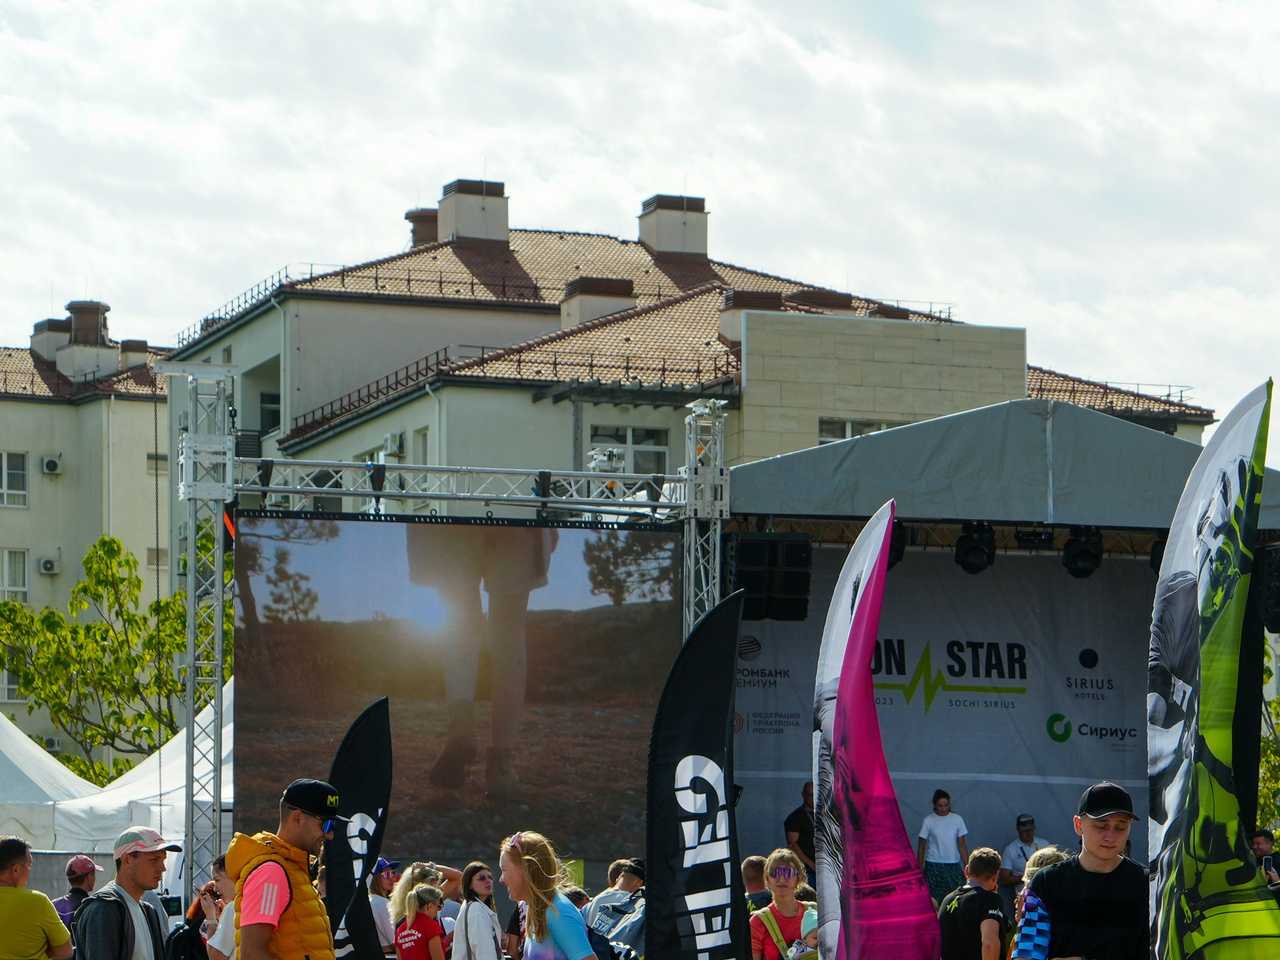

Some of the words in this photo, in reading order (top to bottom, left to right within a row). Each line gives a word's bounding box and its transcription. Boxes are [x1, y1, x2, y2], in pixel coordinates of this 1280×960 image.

[946, 640, 1027, 680] STAR
[1066, 677, 1114, 690] SIRIUS
[1075, 692, 1105, 700] HOTELS
[949, 699, 979, 708] SOCHI
[984, 700, 1016, 709] SIRIUS
[752, 712, 801, 720] ФЕДЕРАЦИЯ
[752, 719, 801, 727] ТРИАТЛОНА
[752, 727, 784, 735] РОССИИ
[1078, 723, 1137, 740] Сириус
